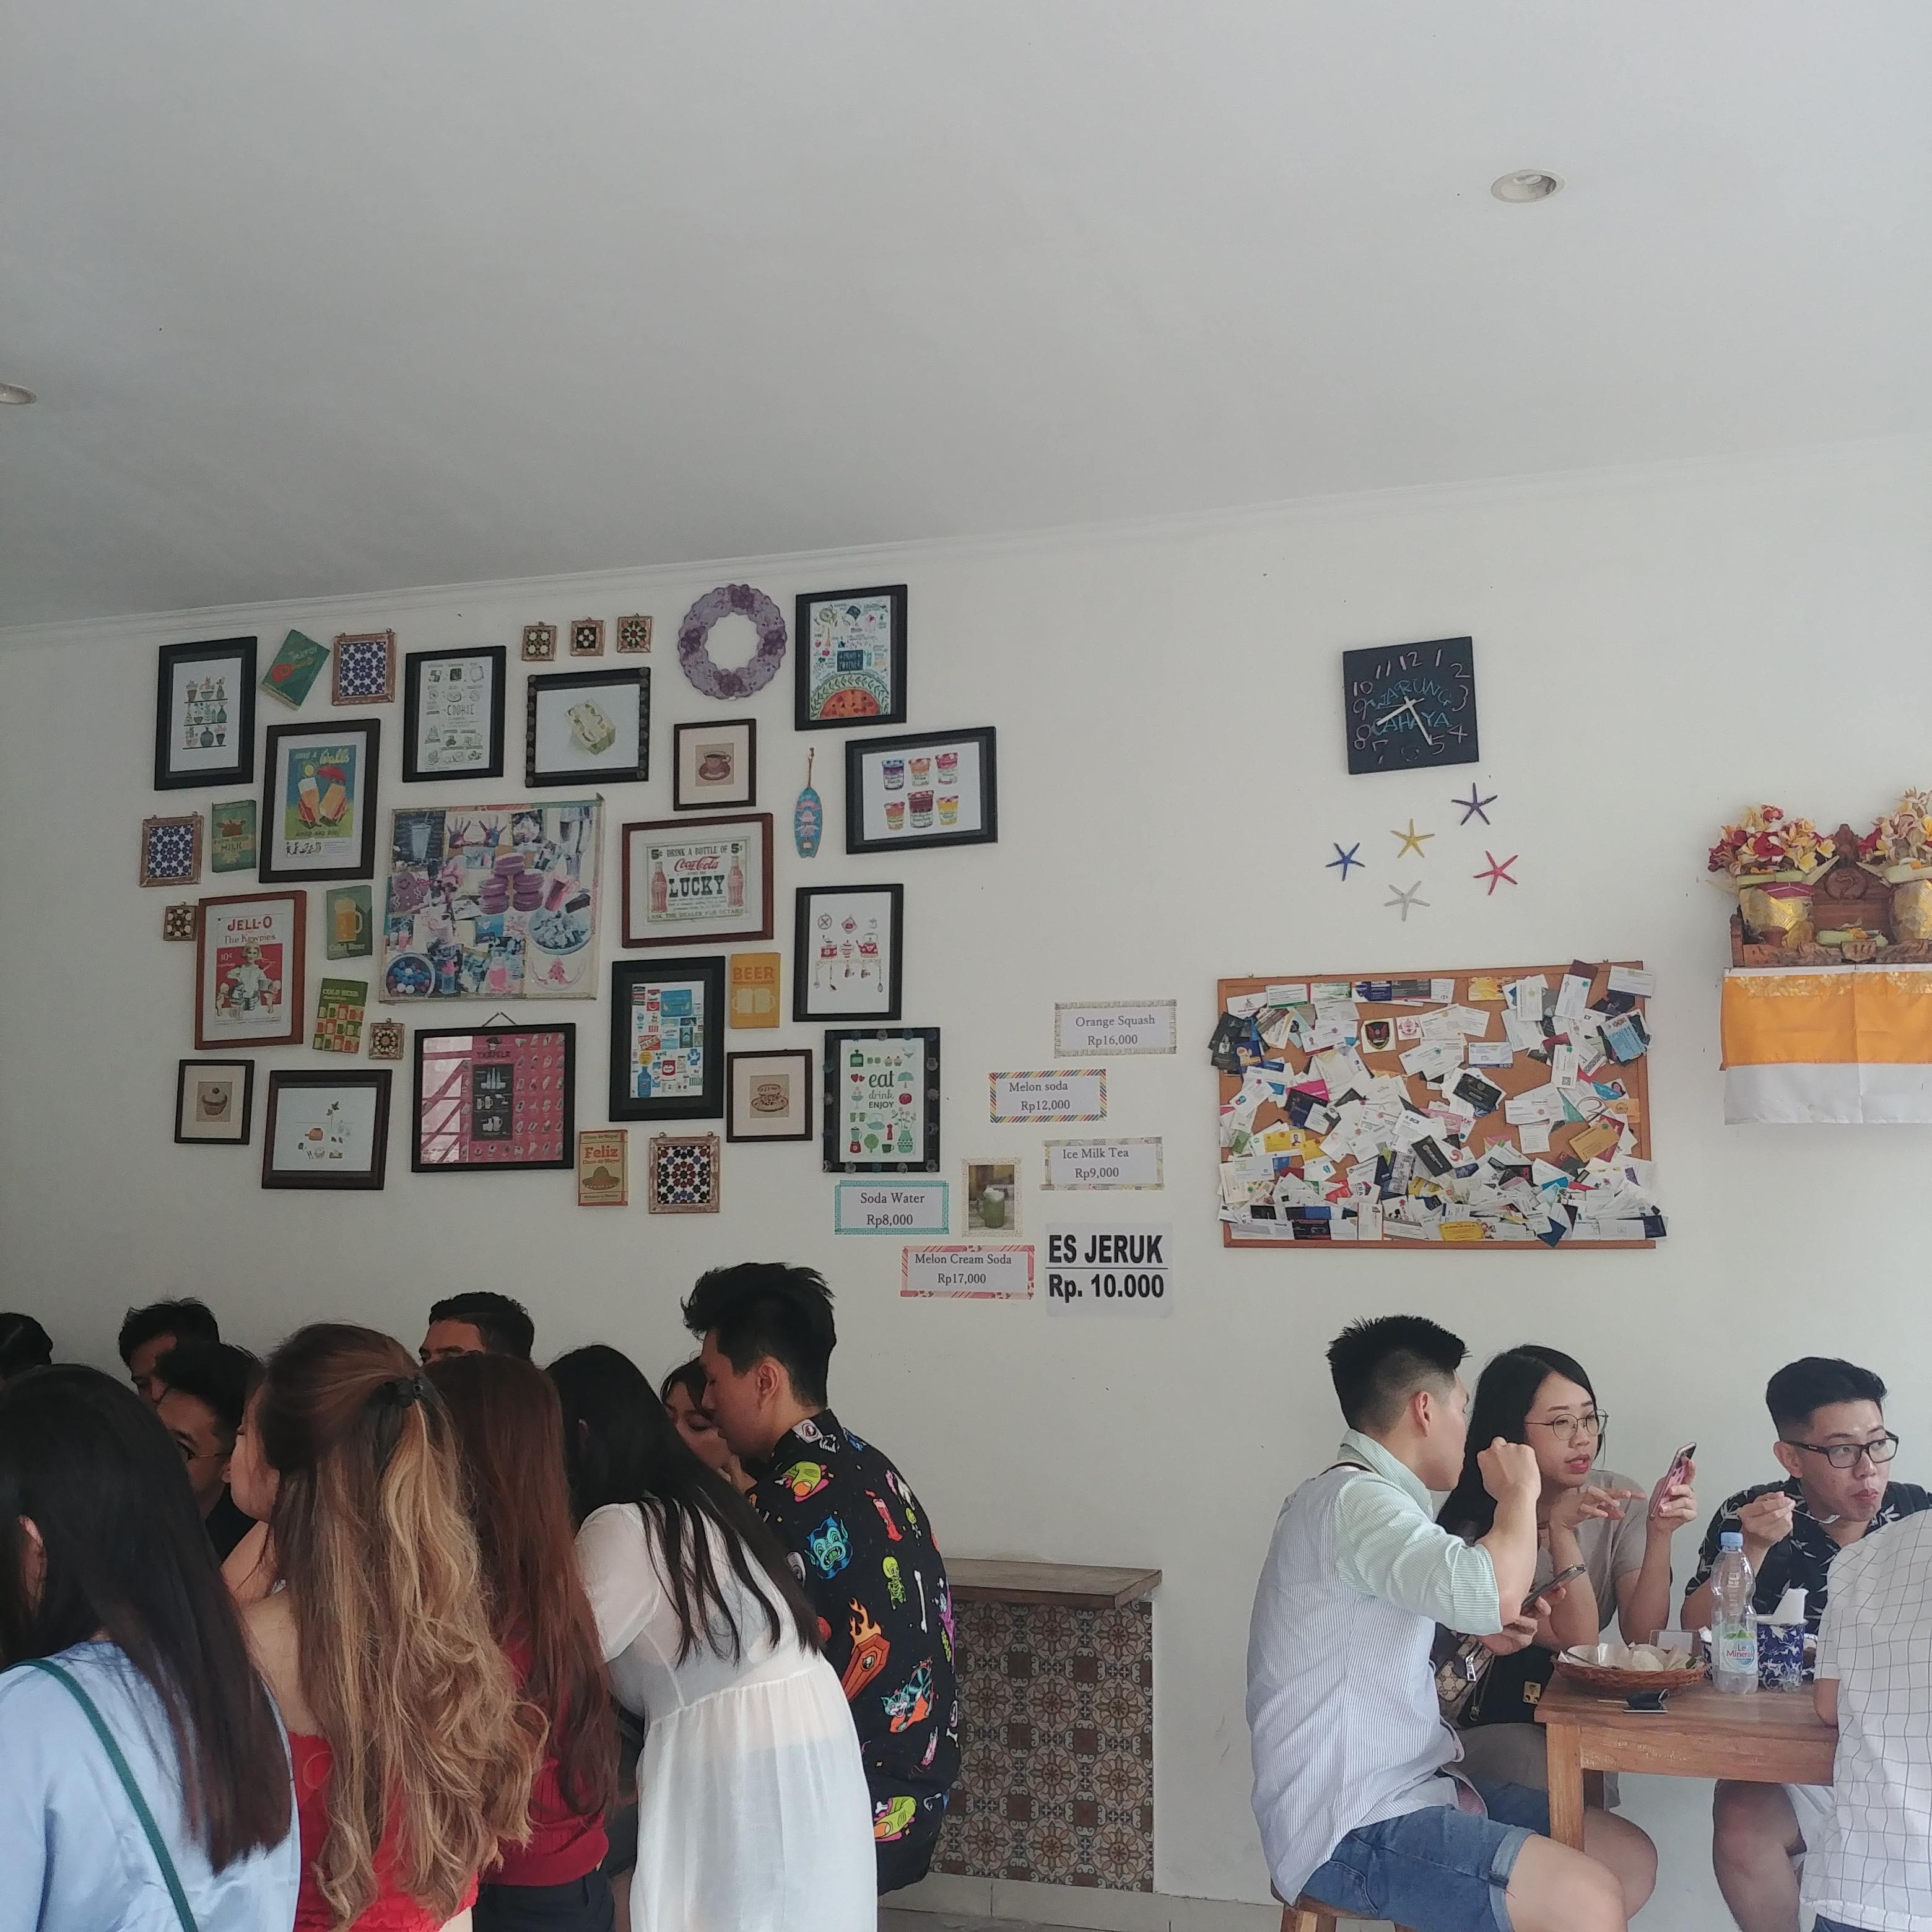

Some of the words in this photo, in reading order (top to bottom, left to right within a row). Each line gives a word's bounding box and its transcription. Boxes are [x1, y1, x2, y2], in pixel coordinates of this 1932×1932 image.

[1399, 651, 1422, 671] 12
[1435, 648, 1442, 667] 1
[1375, 660, 1391, 680] 11
[1450, 663, 1471, 679] 2
[1352, 681, 1373, 697] 10
[1367, 677, 1451, 710] WARUNG
[1451, 684, 1469, 712] 3
[1352, 698, 1368, 721] 9
[1372, 711, 1451, 736] CAHAYA
[1354, 724, 1372, 751] 8
[1447, 723, 1468, 744] 4
[1371, 739, 1388, 765] 7
[1429, 734, 1445, 755] 5
[667, 848, 685, 858] DRINK
[695, 846, 718, 855] BOTTLE
[720, 845, 728, 853] OF
[668, 874, 725, 898] LUCKY
[227, 916, 272, 932] JELL-O
[224, 935, 240, 944] The
[733, 966, 774, 980] BEER
[1075, 1016, 1115, 1029] Orange
[1118, 1014, 1155, 1028] Squash
[1087, 1033, 1138, 1049] Rp16,000
[868, 1070, 895, 1089] eat
[1009, 1081, 1042, 1092] Melon
[1045, 1080, 1069, 1091] soda
[868, 1089, 894, 1100] drink
[868, 1101, 895, 1110] ENJOY
[1020, 1099, 1071, 1113] Rp12,000
[584, 1144, 619, 1159] Feliz
[1063, 1149, 1079, 1160] Ice
[1081, 1147, 1106, 1159] Milk
[1108, 1147, 1129, 1158] Tea
[1074, 1167, 1120, 1181] Rp9,000
[859, 1191, 887, 1204] Soda
[890, 1191, 925, 1204] Water
[866, 1213, 913, 1229] Rp8,000
[1048, 1234, 1077, 1264] ES
[1084, 1234, 1164, 1264] JERUK
[915, 1253, 947, 1264] Melon
[950, 1253, 984, 1264] Cream
[986, 1253, 1012, 1264] Soda
[937, 1273, 986, 1287] Rp17,000
[1048, 1273, 1083, 1303] Rp.
[1090, 1273, 1165, 1298] 10.000
[1738, 1643, 1746, 1651] Le
